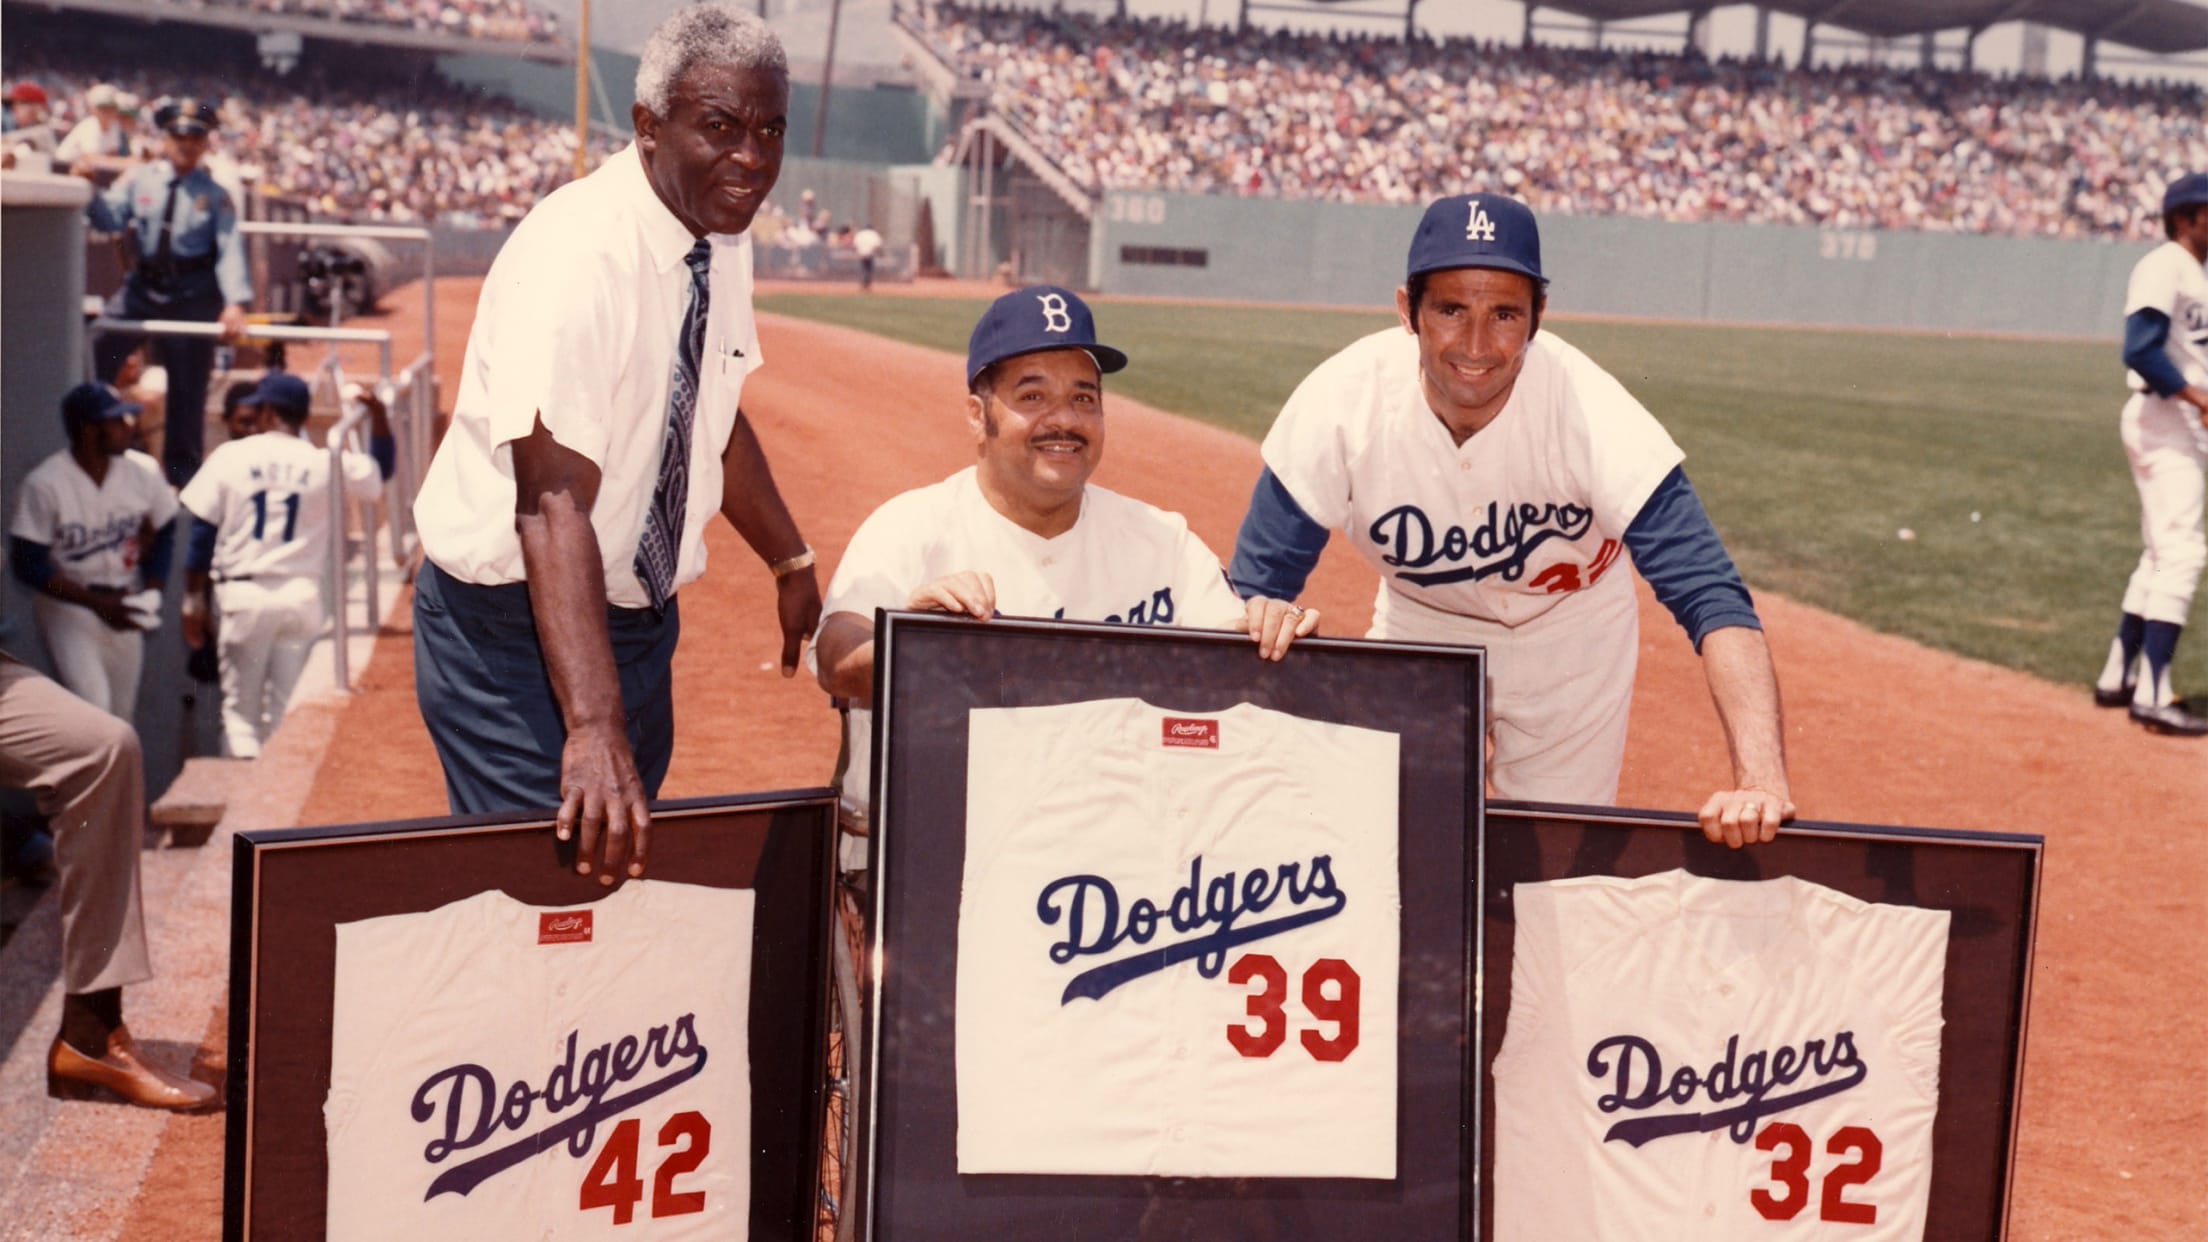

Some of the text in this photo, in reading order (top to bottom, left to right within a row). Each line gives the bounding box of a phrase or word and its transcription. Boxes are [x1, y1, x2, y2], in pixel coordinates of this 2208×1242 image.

[1466, 200, 1495, 241] LA
[1036, 293, 1072, 332] B
[251, 490, 301, 543] 11
[1037, 854, 1347, 980] Dodgers
[1226, 953, 1361, 1062] 39
[411, 1012, 708, 1162] Dodgers
[1587, 1031, 1867, 1145] Dodgers
[579, 1111, 711, 1225] 42
[1751, 1122, 1883, 1224] 32
